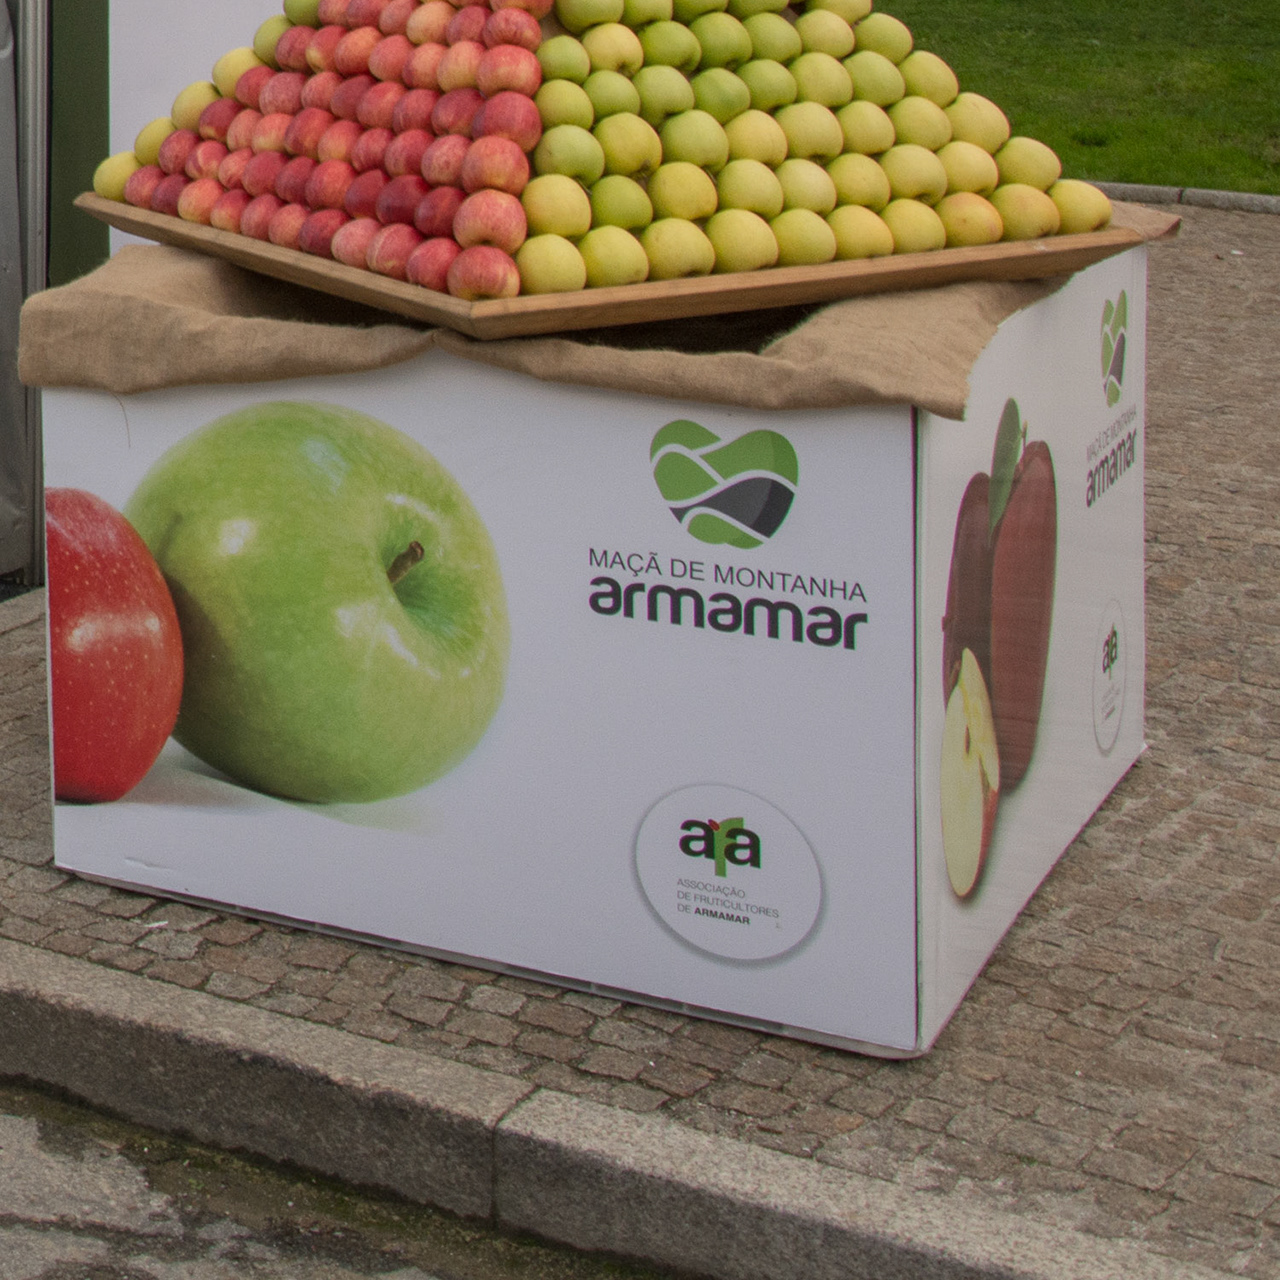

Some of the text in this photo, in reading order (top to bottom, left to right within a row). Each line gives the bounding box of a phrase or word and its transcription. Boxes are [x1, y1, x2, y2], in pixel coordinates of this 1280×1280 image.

[1086, 428, 1137, 508] armamar
[589, 548, 867, 603] MAÇÃ DE MONTANHA
[589, 576, 868, 651] armamar
[676, 878, 746, 899] ASSOCIAÇÃO
[676, 890, 779, 919] DE FRUTICULTORES
[676, 903, 751, 925] DE ARMAMAR
